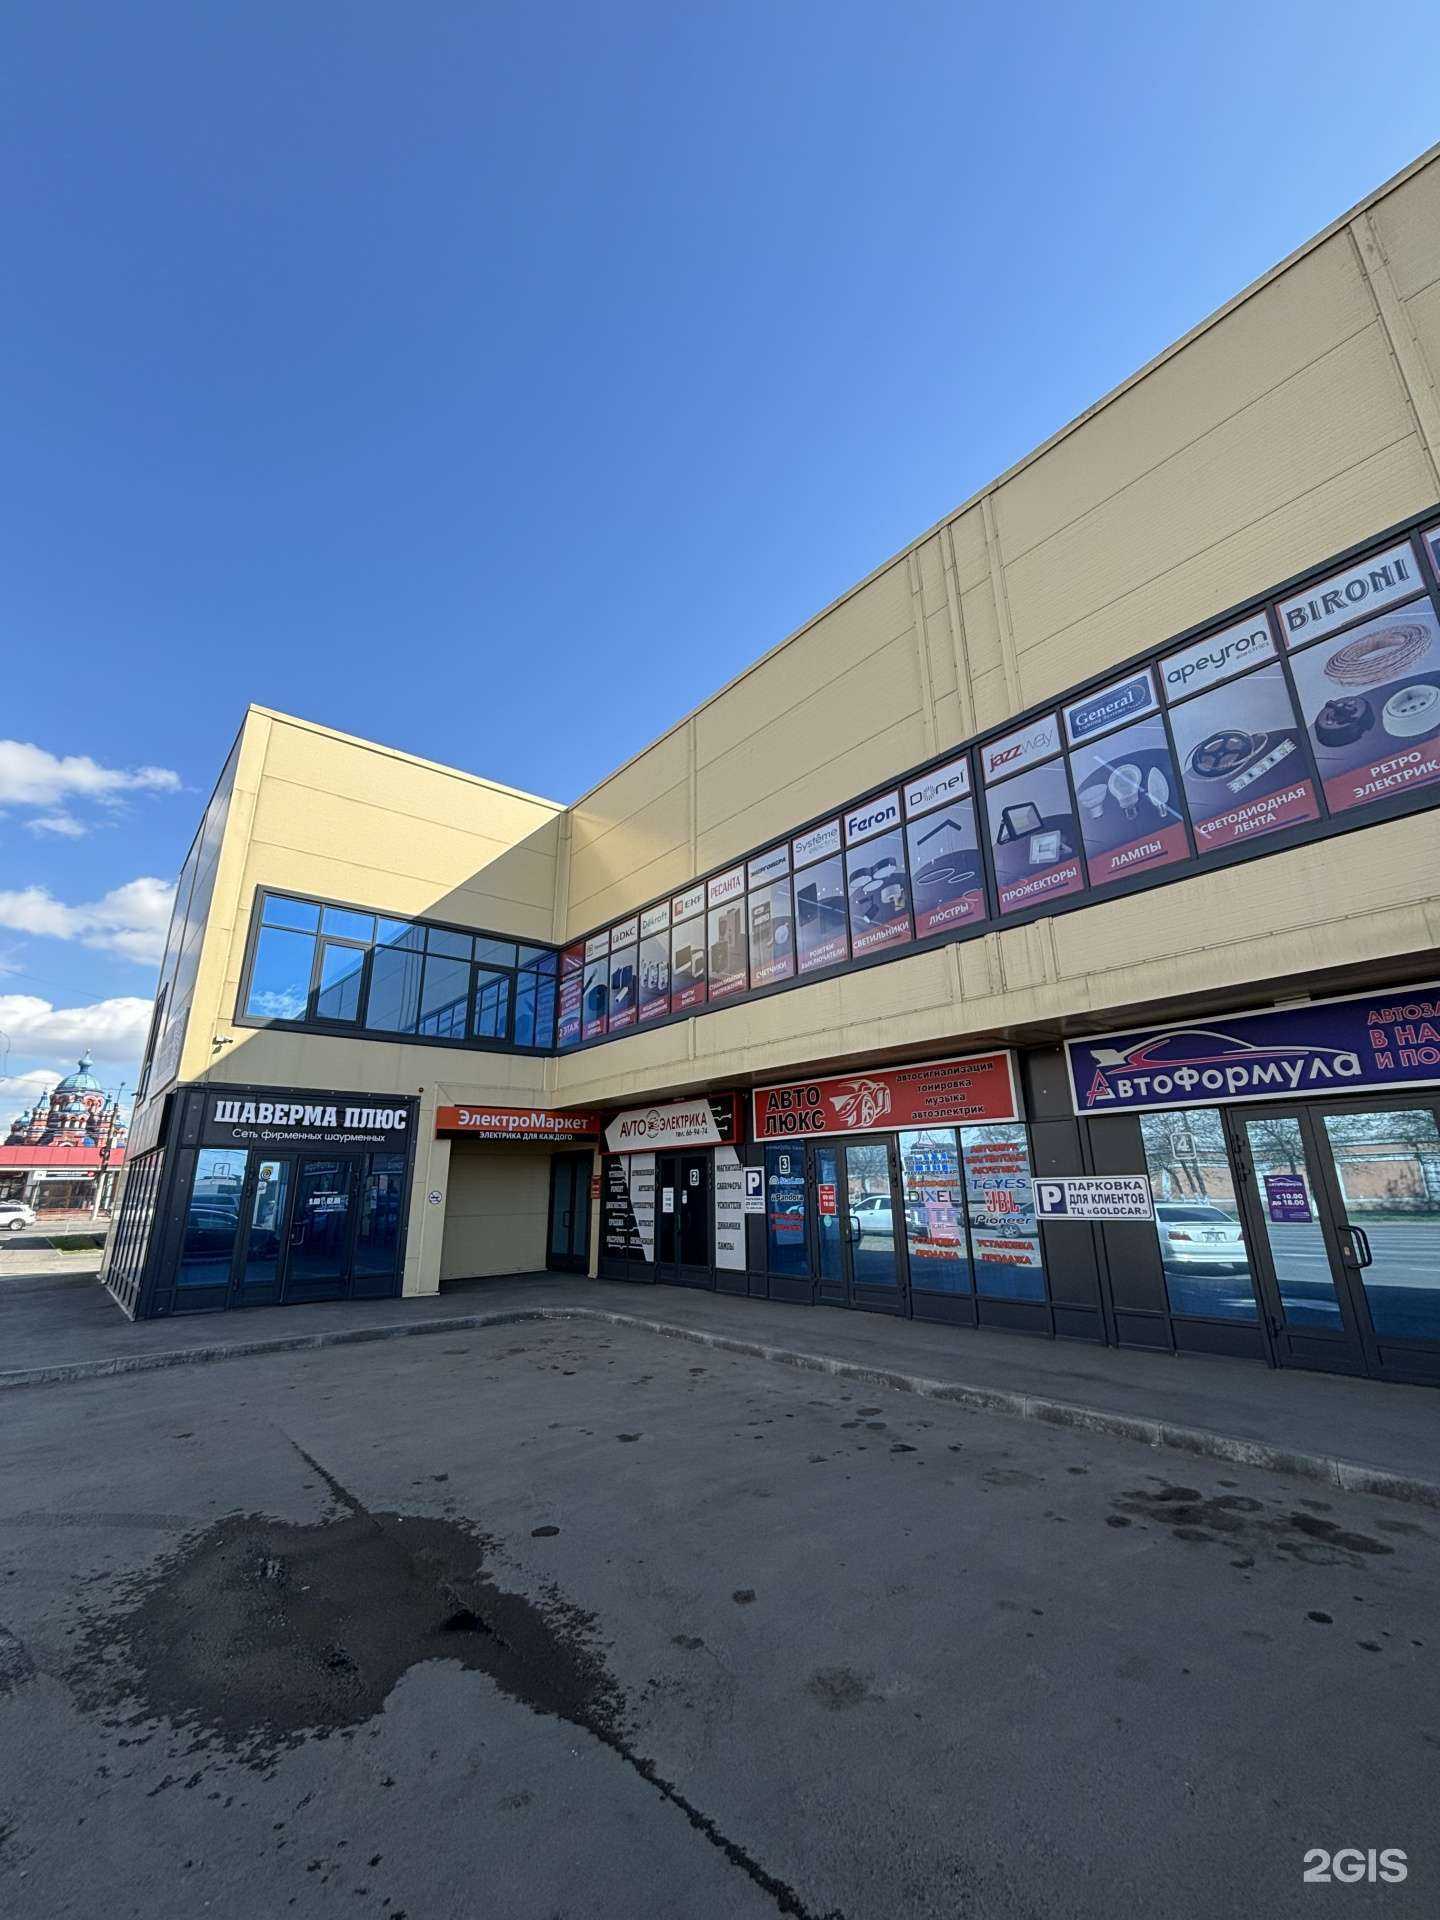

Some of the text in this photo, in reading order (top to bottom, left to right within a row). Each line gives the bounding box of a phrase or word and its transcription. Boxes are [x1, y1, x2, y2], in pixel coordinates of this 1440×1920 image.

[1285, 559, 1410, 632] BIRONI
[1167, 630, 1269, 684] apeyron
[1076, 690, 1135, 726] General
[989, 728, 1053, 773] jazzway
[1370, 751, 1422, 778] РЕТРО
[1353, 758, 1440, 798] ЭЛЕКТРИК
[848, 806, 896, 837] Feron
[1200, 787, 1307, 835] СВЕТОДИОДНАЯ
[1233, 812, 1276, 835] ЛЕНТА
[1110, 840, 1163, 868] ЛАМПЫ
[711, 875, 741, 899] РЕСАНТА
[1002, 867, 1078, 903] ПРОЖЕКТОРЫ
[929, 903, 969, 926] ЛЮСТРЫ
[853, 921, 909, 950] СВЕТИЛЬНИКИ
[809, 943, 835, 958] РОЗЕТКИ
[1369, 1029, 1388, 1049] В
[1375, 1051, 1395, 1070] И
[896, 1062, 995, 1082] автосигнализация
[917, 1079, 973, 1093] тонировка
[767, 1086, 821, 1111] АВТО
[925, 1093, 967, 1105] музыка
[213, 1100, 407, 1130] ШАВЕРМА ПЛЮС
[458, 1110, 588, 1131] ЭлектроМаркет
[659, 1112, 707, 1131] ЭЛЕКТРИКА
[764, 1109, 826, 1135] ЛЮКС
[911, 1105, 985, 1120] автоэлектрик
[232, 1128, 385, 1143] Сеть фирменных шаурменных
[479, 1131, 573, 1141] ЭЛЕКТРИКА ДЛЯ КАЖДОГО
[1178, 1135, 1190, 1151] 4
[908, 1190, 960, 1203] DIXEL
[1068, 1181, 1143, 1191] ПАРКОВКА
[986, 1191, 1020, 1213] JBL
[1070, 1193, 1145, 1205] ДЛЯ КЛИЕНТОВ
[974, 1214, 1032, 1225] Pioneer
[1071, 1206, 1148, 1215] ТЦ «GOLDCAR»
